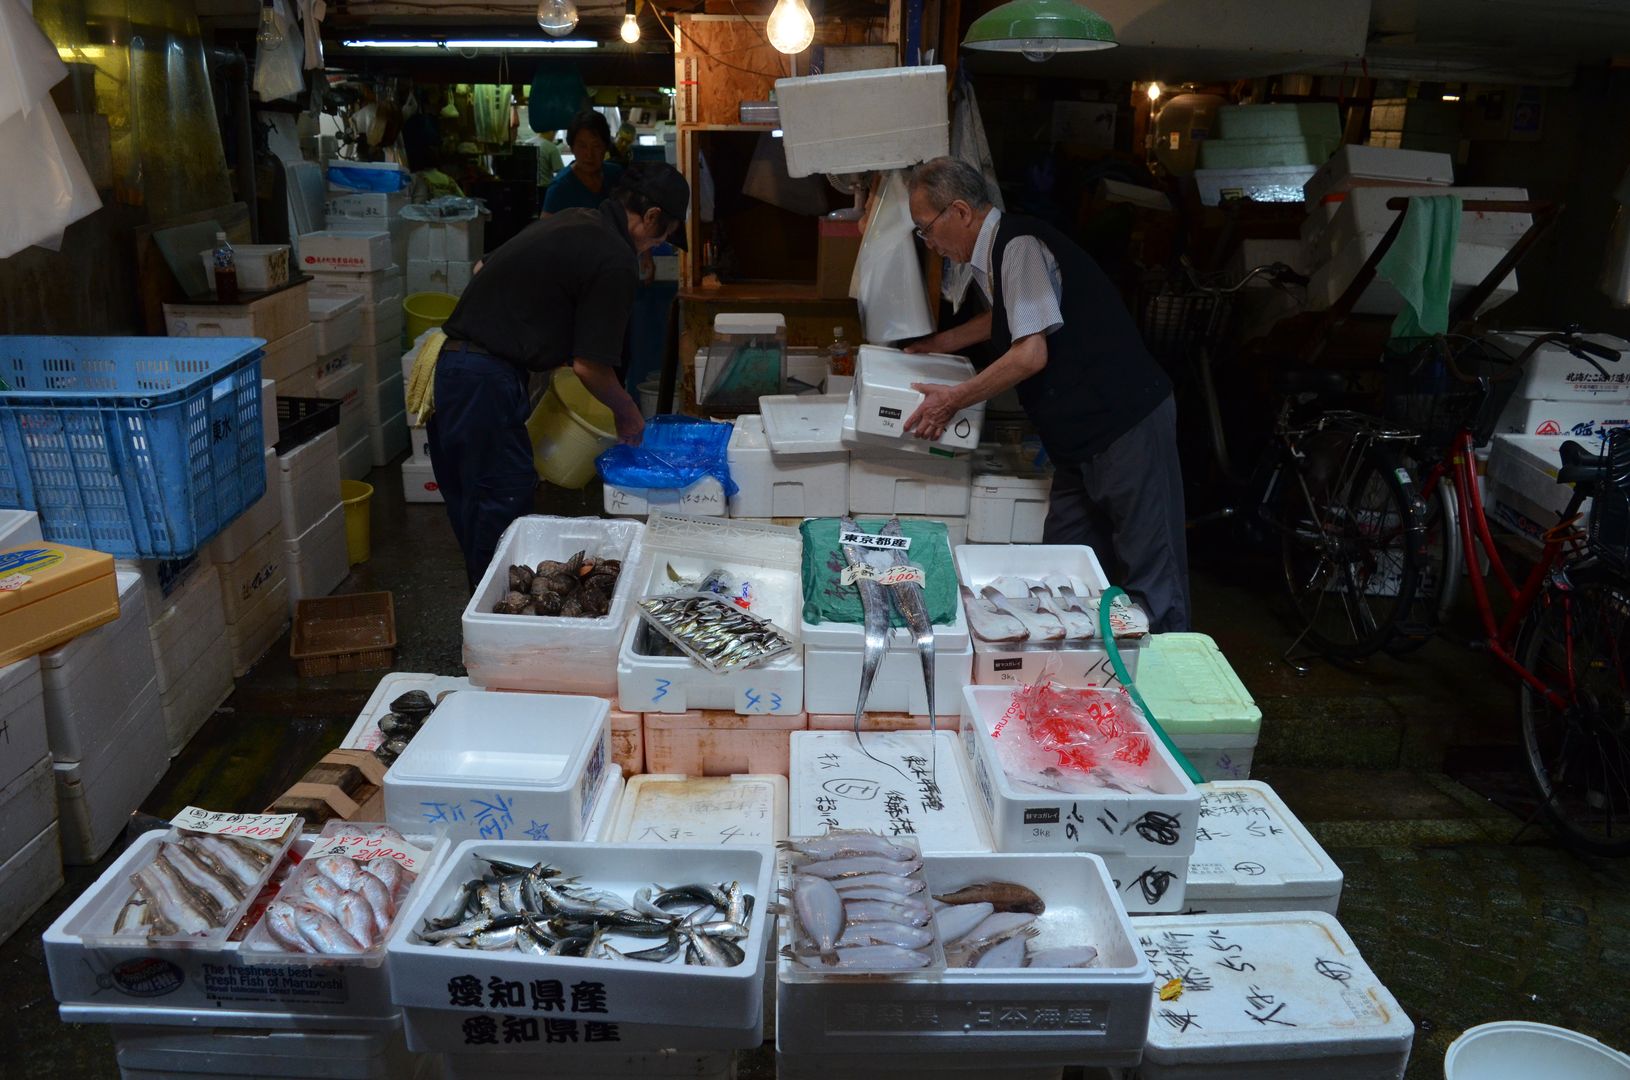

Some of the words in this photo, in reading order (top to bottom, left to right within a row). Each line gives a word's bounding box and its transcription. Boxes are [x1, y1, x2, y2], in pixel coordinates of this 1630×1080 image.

[845, 533, 907, 548] 東京都産
[1032, 828, 1051, 838] 3kg
[203, 964, 227, 975] The
[229, 964, 285, 977] freshness
[287, 966, 313, 978] best
[204, 974, 237, 986] Fresh
[240, 975, 264, 987] Fish
[267, 977, 279, 987] of
[448, 975, 609, 1014] 愛知県産
[462, 1015, 621, 1045] 愛知県産
